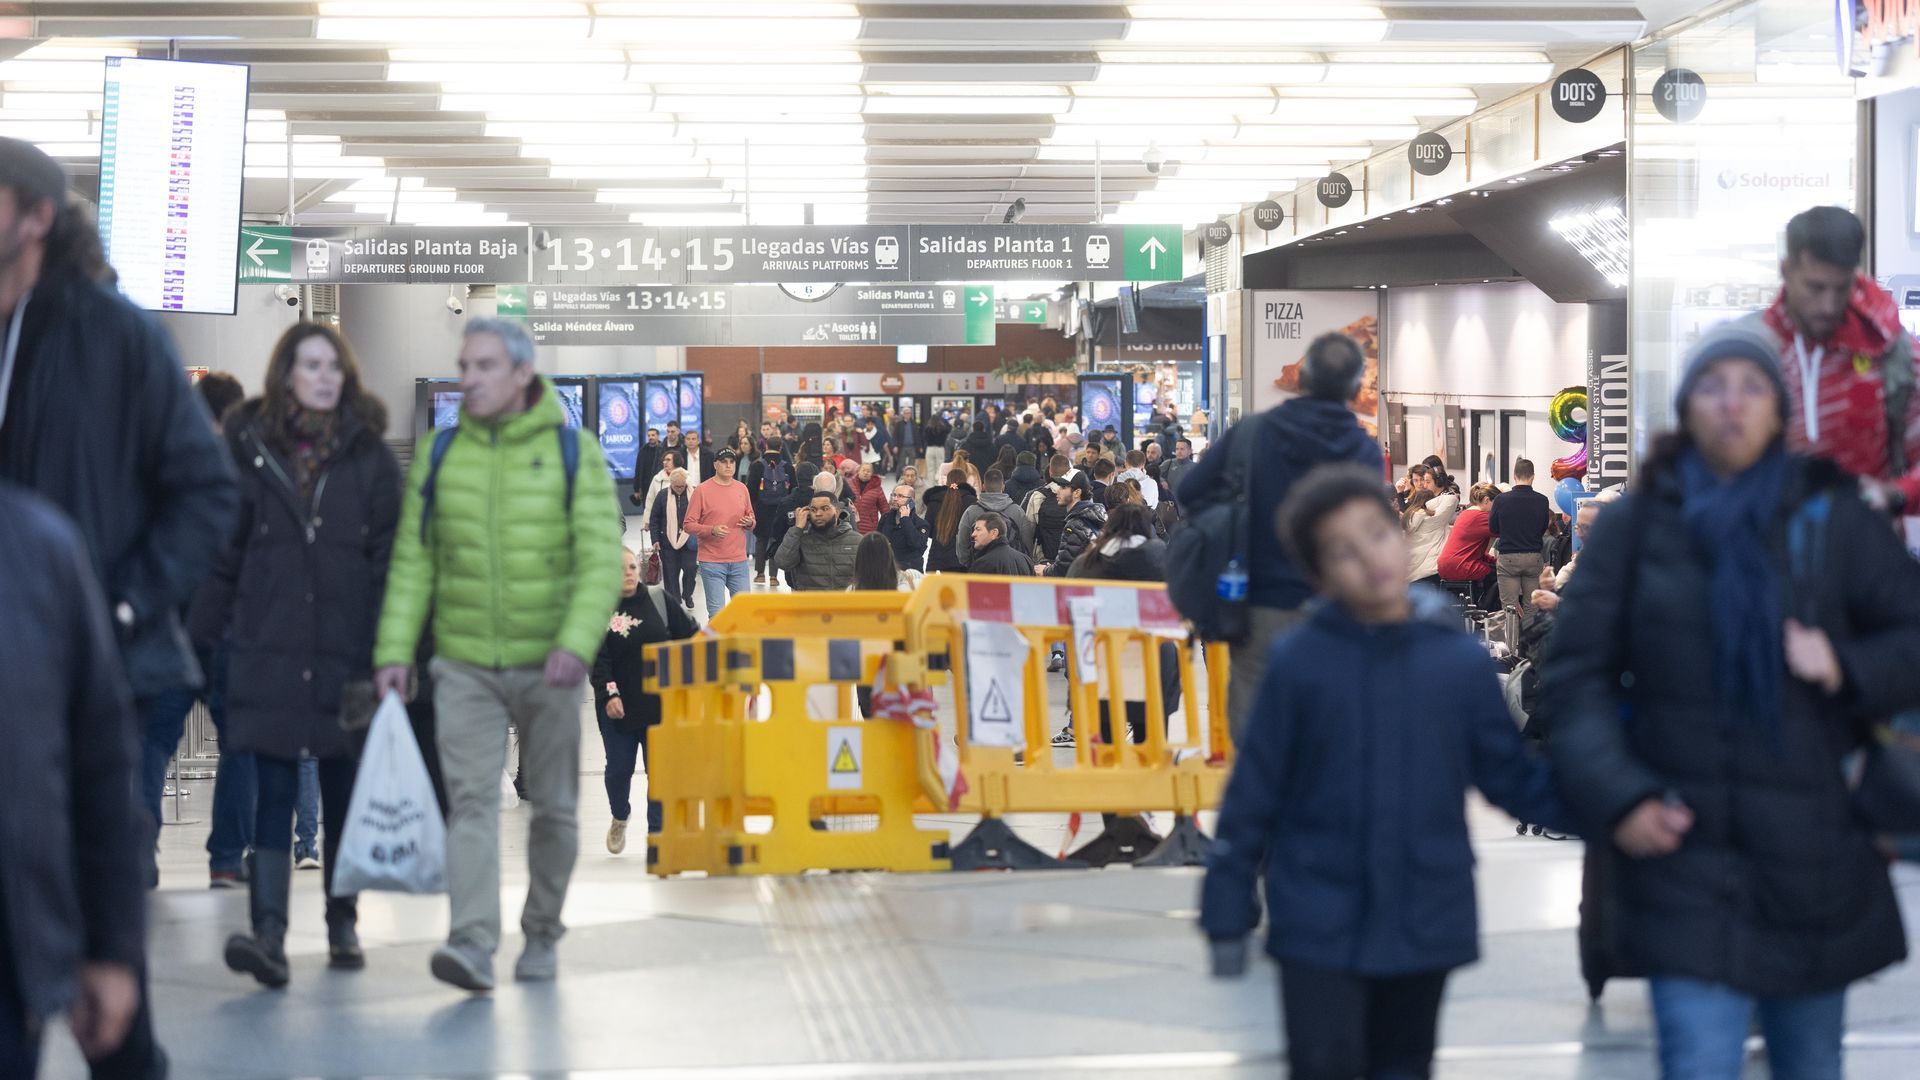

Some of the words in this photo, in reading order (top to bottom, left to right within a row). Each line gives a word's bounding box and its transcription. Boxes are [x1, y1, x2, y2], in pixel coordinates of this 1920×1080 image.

[1560, 82, 1595, 101] DOTS
[1416, 144, 1444, 159] DOTS
[1740, 172, 1830, 191] Soloptical
[1322, 182, 1345, 195] DOTS
[1258, 209, 1278, 219] DOTS
[1209, 227, 1227, 236] DOTS
[344, 238, 408, 255] Salidas
[414, 240, 472, 255] Planta
[479, 238, 518, 259] Baja
[742, 238, 825, 258] Llegadas
[830, 236, 868, 254] Vías
[920, 236, 986, 253] Salidas
[994, 237, 1054, 252] Planta
[1062, 237, 1072, 252] 1
[344, 264, 405, 273] DEPARTURES
[408, 264, 450, 274] GROUND
[454, 264, 484, 273] FLOOR
[762, 261, 809, 270] ARRIVALS
[812, 261, 869, 270] PLATFORMS
[967, 259, 1028, 269] DEPARTURES
[1032, 259, 1062, 269] FLOOR
[1067, 259, 1072, 268] 1
[553, 292, 597, 303] Llegadas
[600, 291, 620, 301] Vías
[858, 290, 891, 300] Salidas
[894, 291, 925, 300] Planta
[928, 291, 934, 299] 1
[1265, 303, 1303, 320] PIZZA
[533, 323, 562, 331] Salida
[565, 322, 602, 331] Méndez
[604, 320, 634, 331] Álvaro
[832, 323, 859, 333] Aseos
[1265, 322, 1301, 339] TIME!
[605, 434, 633, 444] JABUGO
